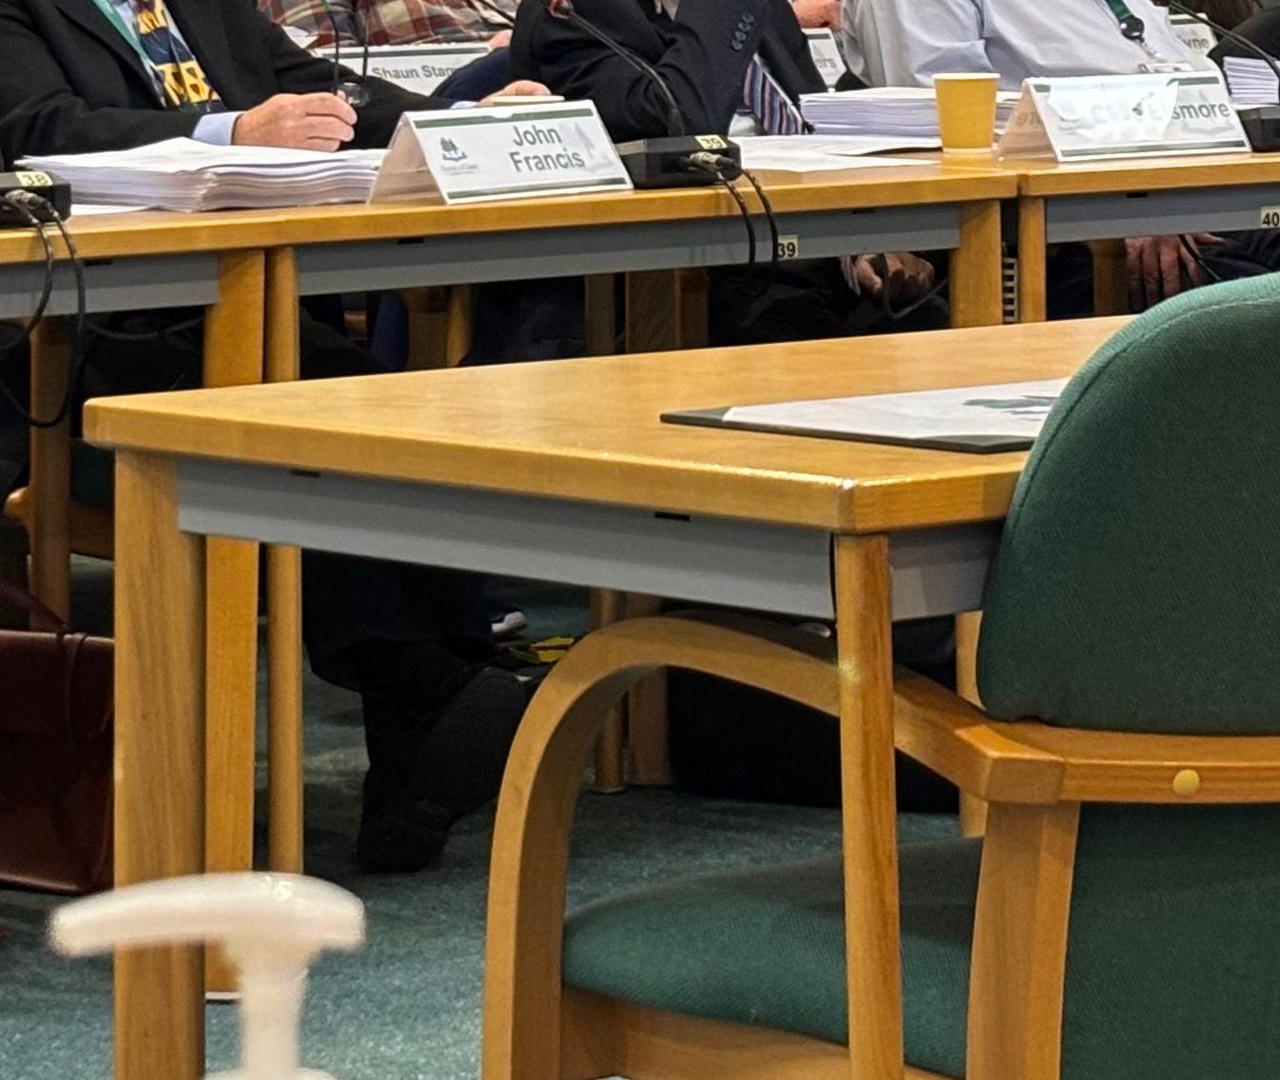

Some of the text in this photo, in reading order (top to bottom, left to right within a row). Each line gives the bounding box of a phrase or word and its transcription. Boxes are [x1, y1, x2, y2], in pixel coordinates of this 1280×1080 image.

[372, 66, 420, 79] Shaun
[512, 124, 563, 146] John
[509, 147, 585, 172] Francis
[22, 174, 49, 186] 38
[1262, 212, 1280, 227] 40
[777, 241, 796, 257] 39
